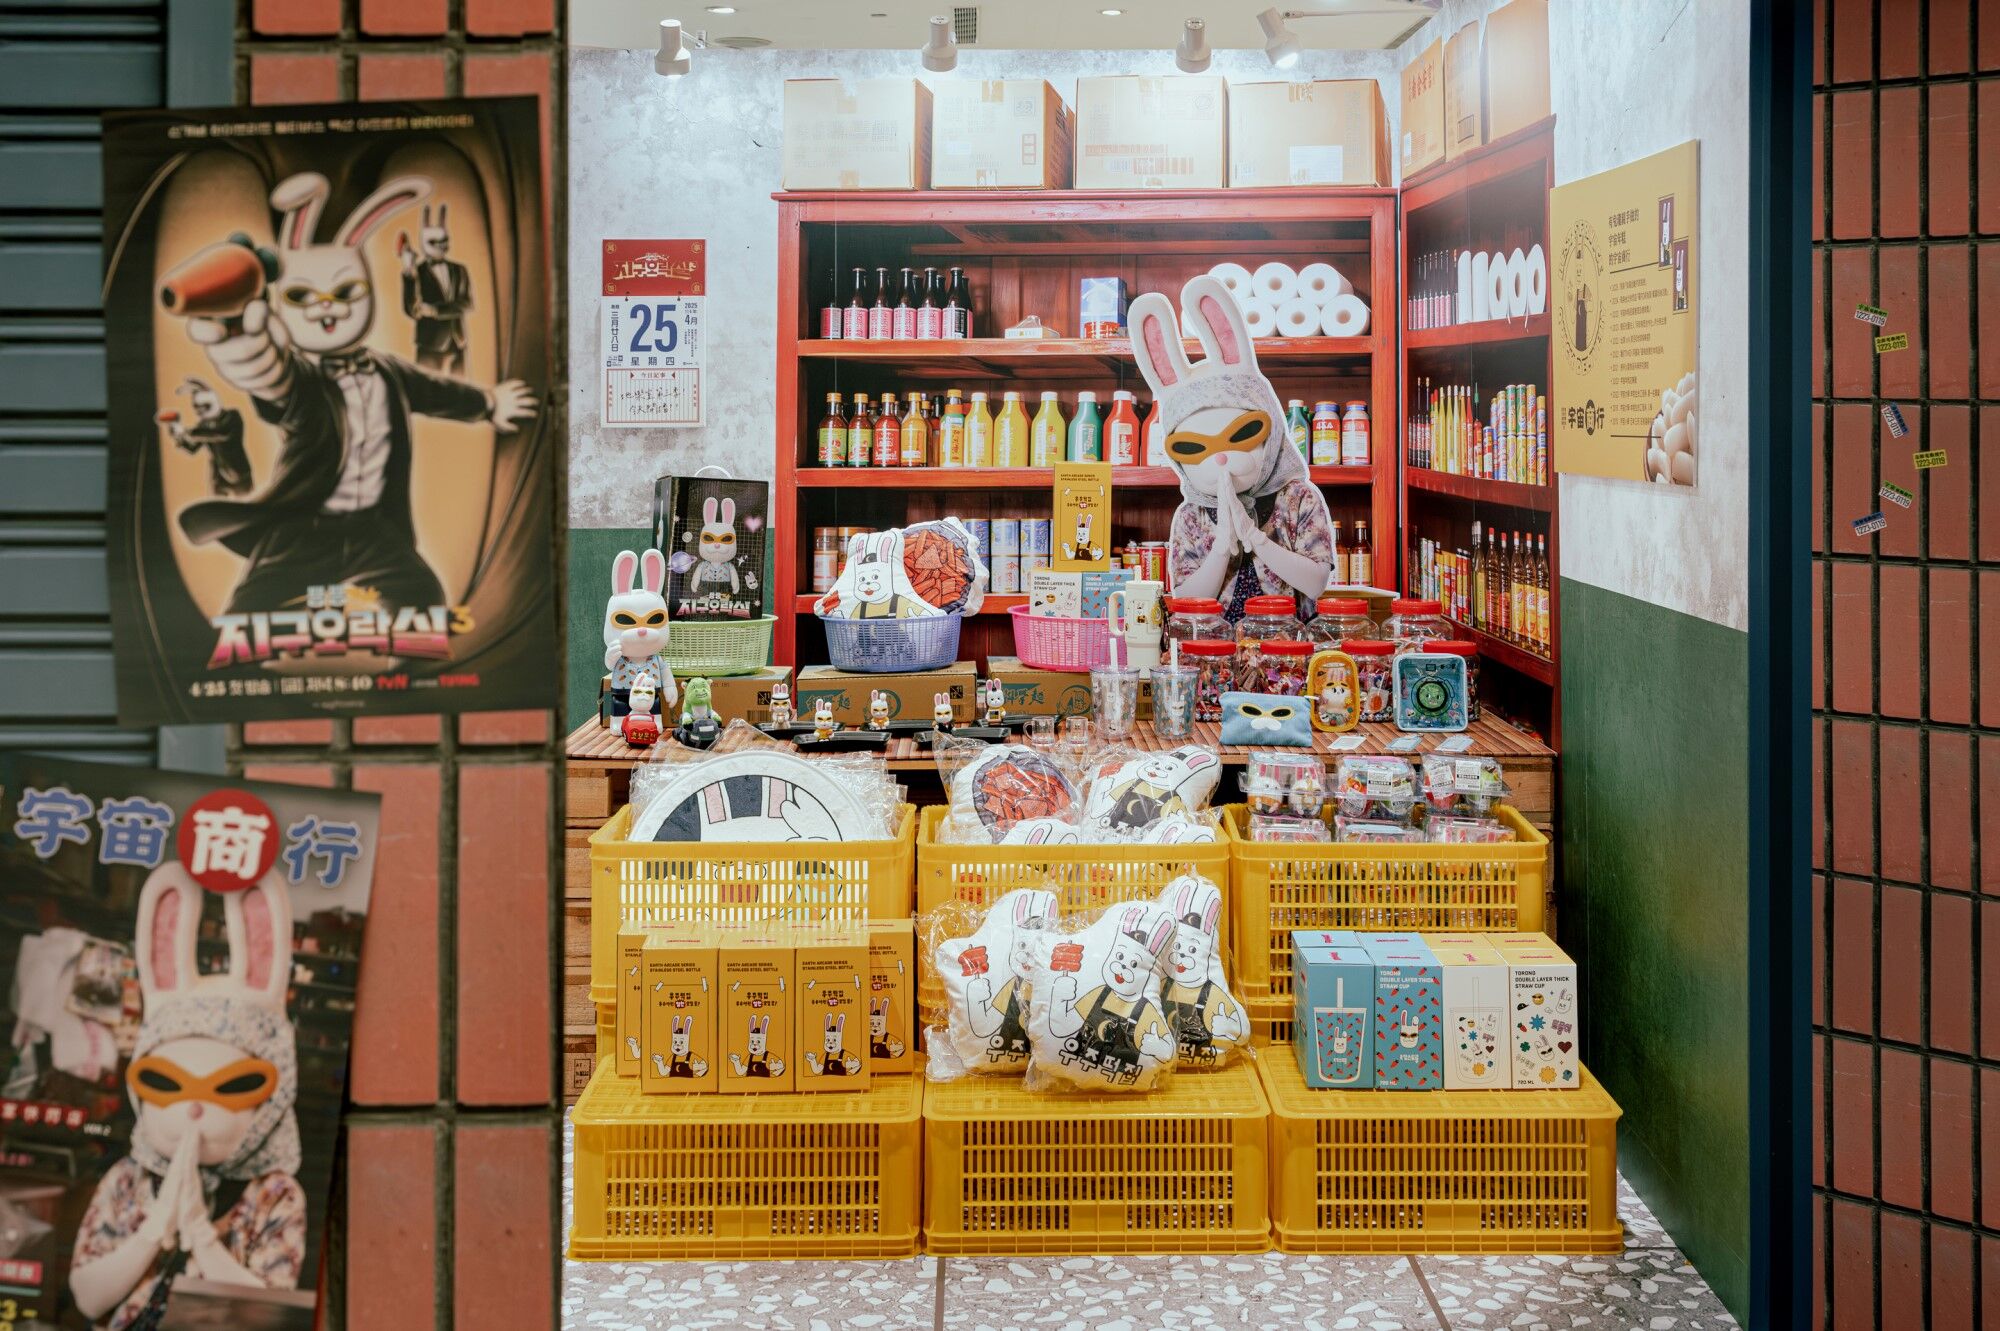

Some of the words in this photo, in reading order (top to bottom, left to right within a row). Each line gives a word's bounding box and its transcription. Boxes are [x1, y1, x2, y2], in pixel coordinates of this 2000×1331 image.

[610, 311, 619, 352] 三月廿八日
[629, 303, 679, 353] 25
[684, 314, 698, 326] 4月
[630, 357, 676, 366] 星期四
[1876, 338, 1907, 352] 1223-0119
[1915, 456, 1946, 468] 1223-0119
[207, 606, 455, 670] 지구오락실
[450, 605, 476, 634] 3
[13, 786, 364, 888] 宇宙商行
[1058, 1038, 1144, 1086] 우주떡집
